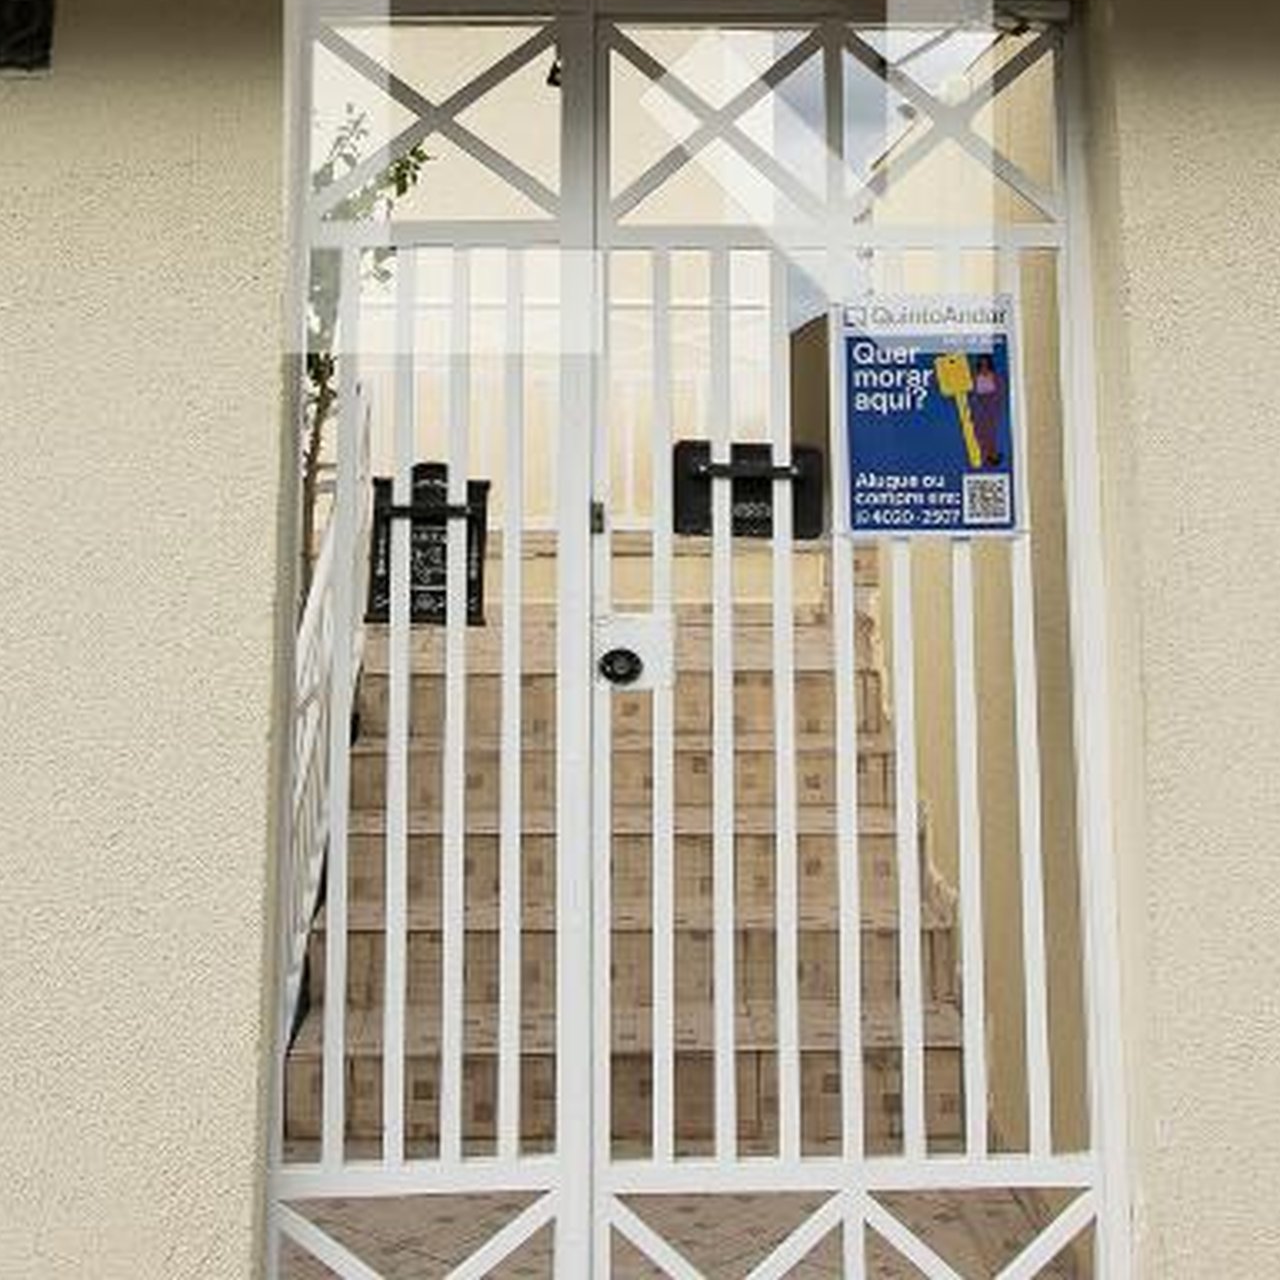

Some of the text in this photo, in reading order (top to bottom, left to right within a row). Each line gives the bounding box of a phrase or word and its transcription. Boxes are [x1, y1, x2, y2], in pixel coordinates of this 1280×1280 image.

[870, 306, 1007, 325] QuintoAndar
[852, 341, 919, 365] Quer
[854, 368, 933, 388] morar
[854, 386, 928, 414] aqui?
[922, 475, 945, 488] ou
